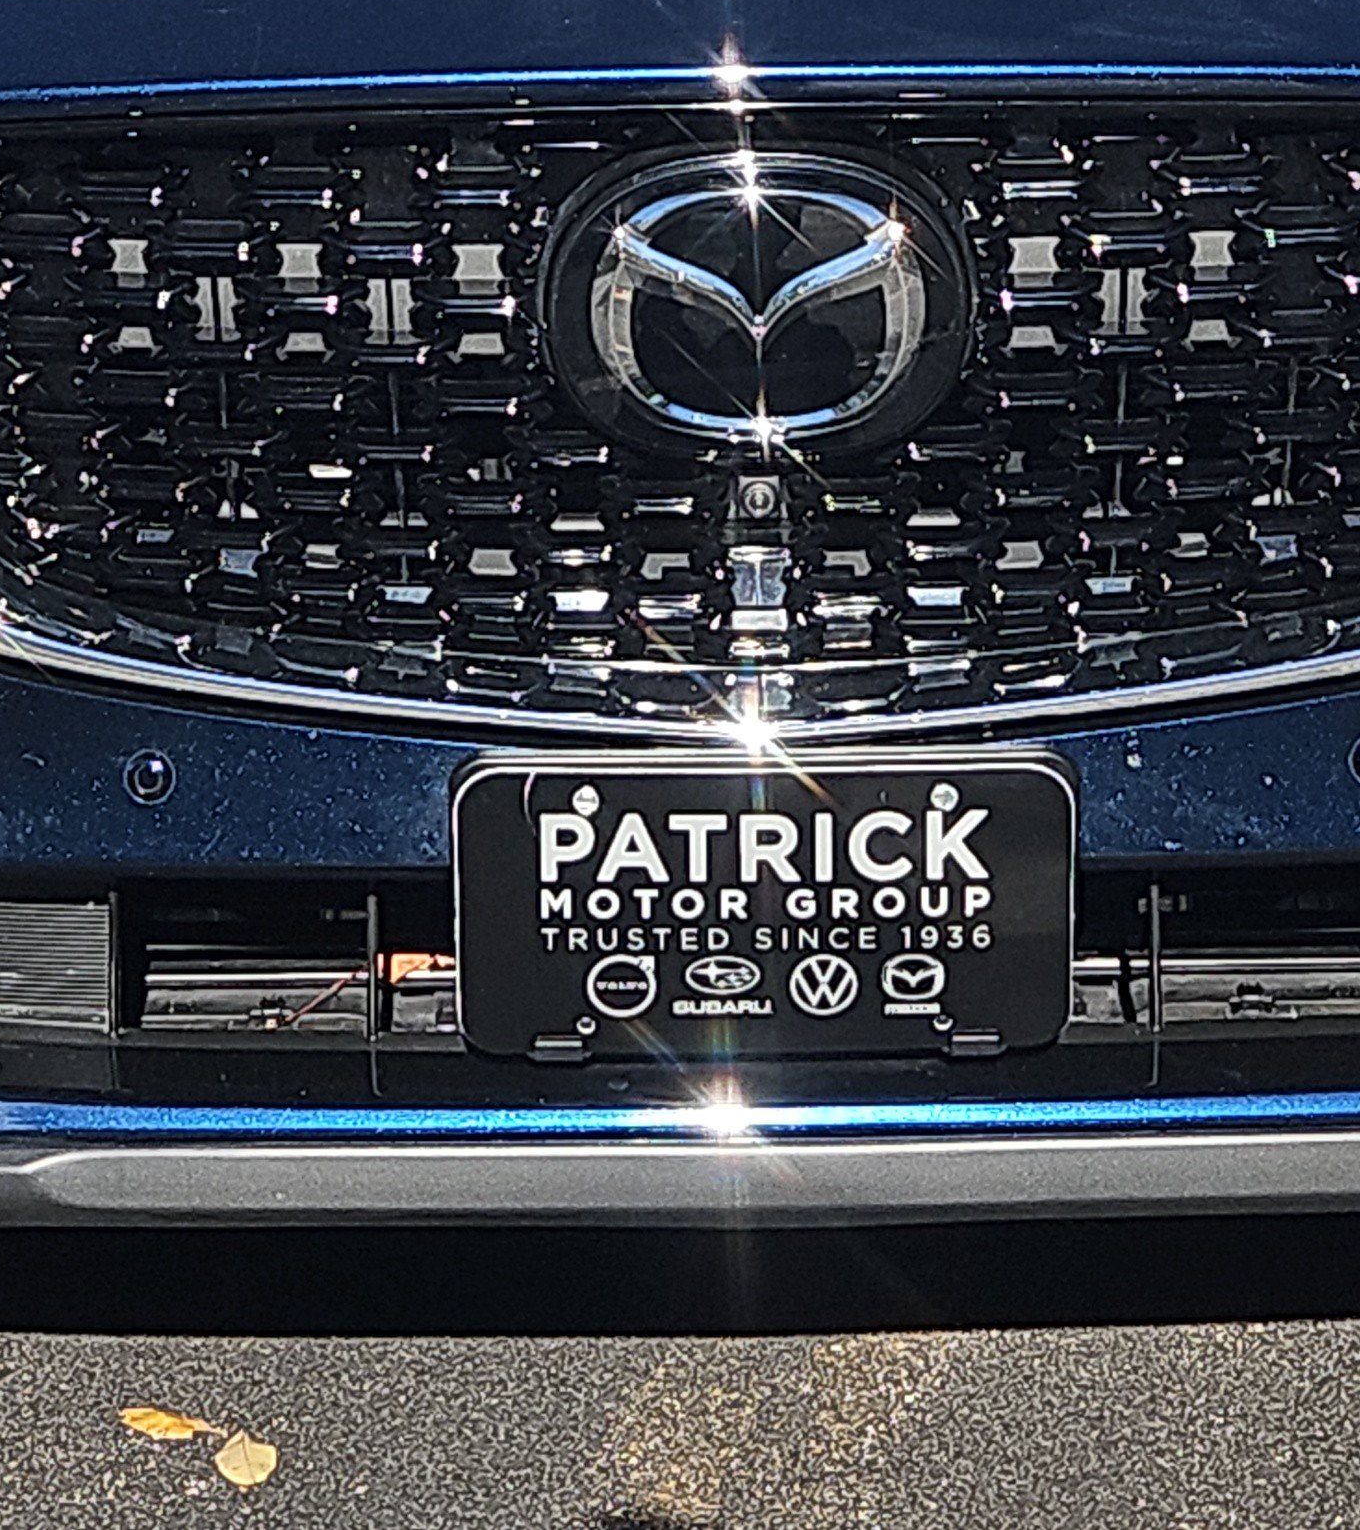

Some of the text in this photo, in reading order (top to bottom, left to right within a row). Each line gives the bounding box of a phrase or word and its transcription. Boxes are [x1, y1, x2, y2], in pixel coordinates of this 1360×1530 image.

[539, 808, 990, 883] PATRICK
[540, 886, 991, 920] MOTOR GROUP
[540, 924, 991, 951] TRUSTED SINCE 1936
[672, 999, 774, 1016] SUBARU
